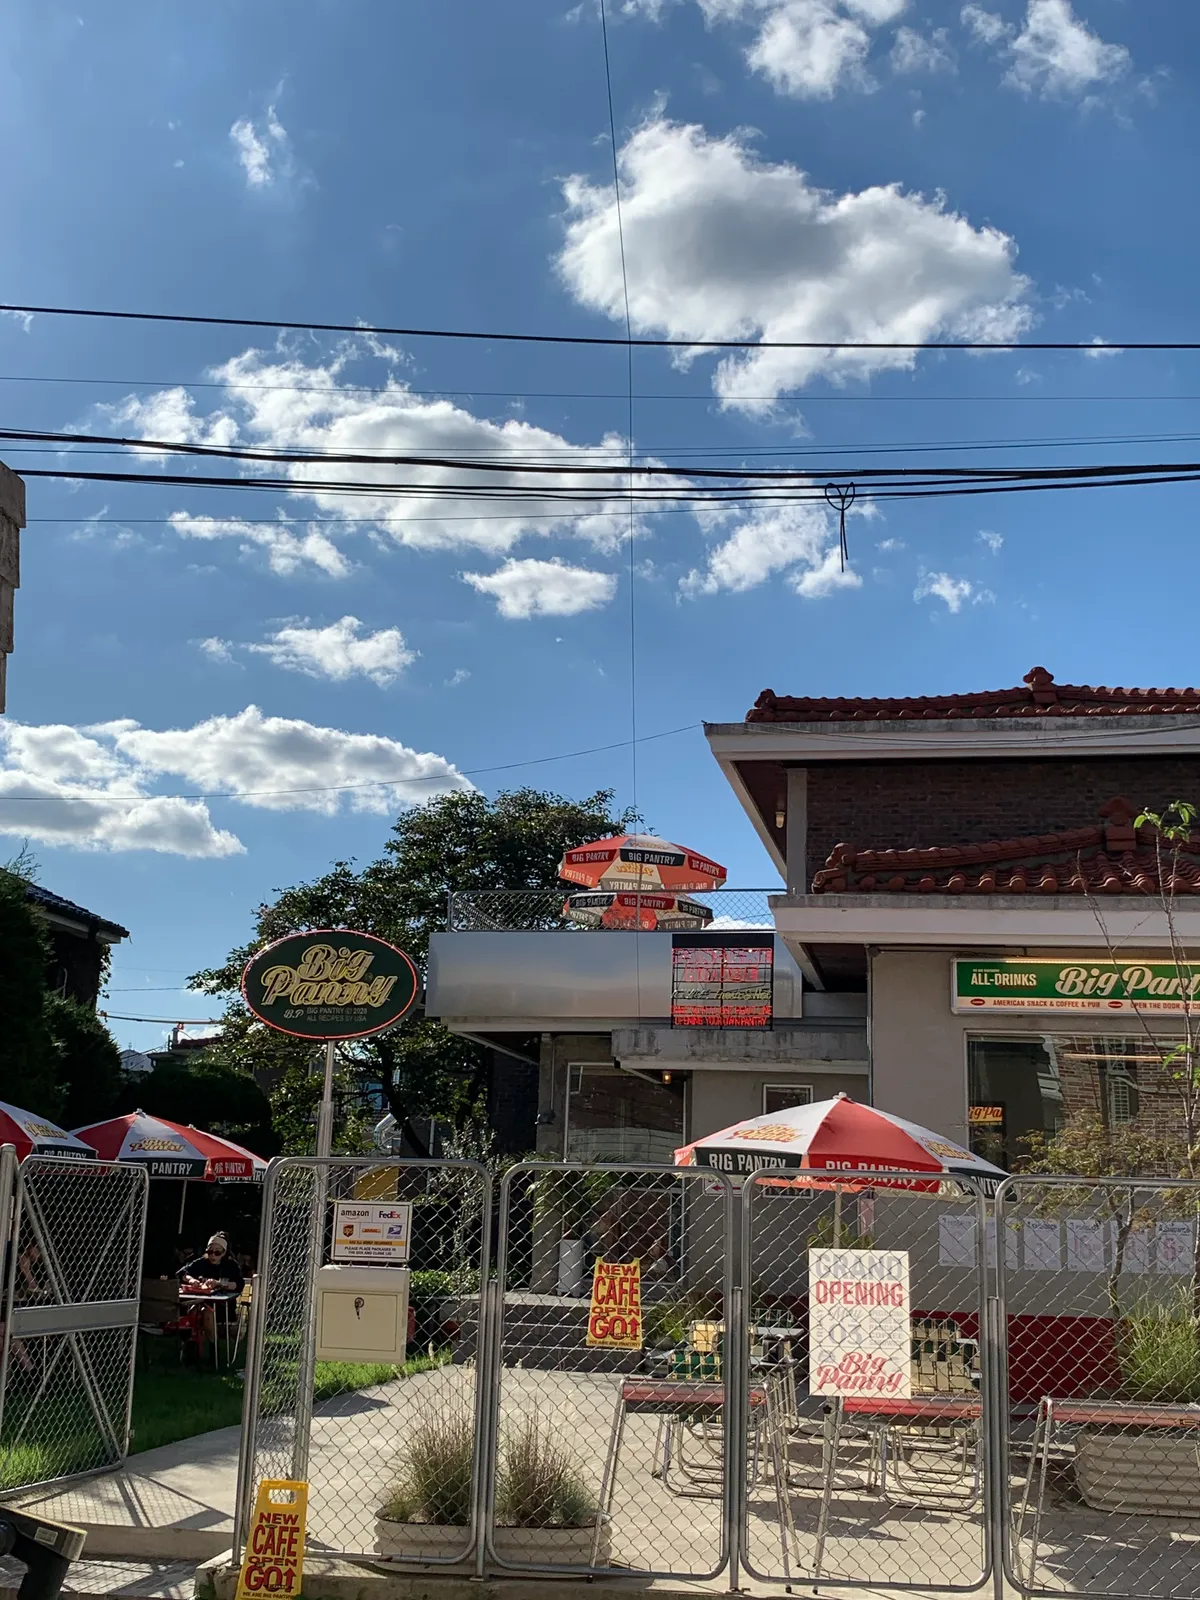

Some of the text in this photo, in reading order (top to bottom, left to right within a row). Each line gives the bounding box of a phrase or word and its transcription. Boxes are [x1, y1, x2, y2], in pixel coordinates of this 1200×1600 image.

[572, 851, 610, 862] BIG PANTRY
[628, 852, 676, 865] BIG PANTRY
[700, 861, 720, 875] PANTRY
[623, 897, 666, 908] BIG PANTRY
[297, 943, 375, 982] Big
[971, 972, 1037, 986] ALL-DRINKS
[1055, 966, 1121, 996] Big
[319, 1007, 345, 1015] PANTRY
[151, 1162, 193, 1175] PANTRY
[709, 1153, 733, 1171] BIG
[737, 1154, 787, 1172] PANTRY
[341, 1209, 401, 1219] amazon FedEx
[598, 1263, 637, 1276] NEW
[815, 1254, 904, 1281] GRAND
[594, 1275, 640, 1307] CAFE
[815, 1280, 904, 1307] OPENING
[592, 1306, 640, 1317] OPEN
[590, 1314, 628, 1340] GO
[839, 1352, 888, 1375] Big
[817, 1364, 904, 1393] Pantry
[259, 1512, 299, 1525] NEW
[252, 1524, 300, 1557] CAFE
[248, 1556, 298, 1567] OPEN
[245, 1565, 284, 1592] GO
